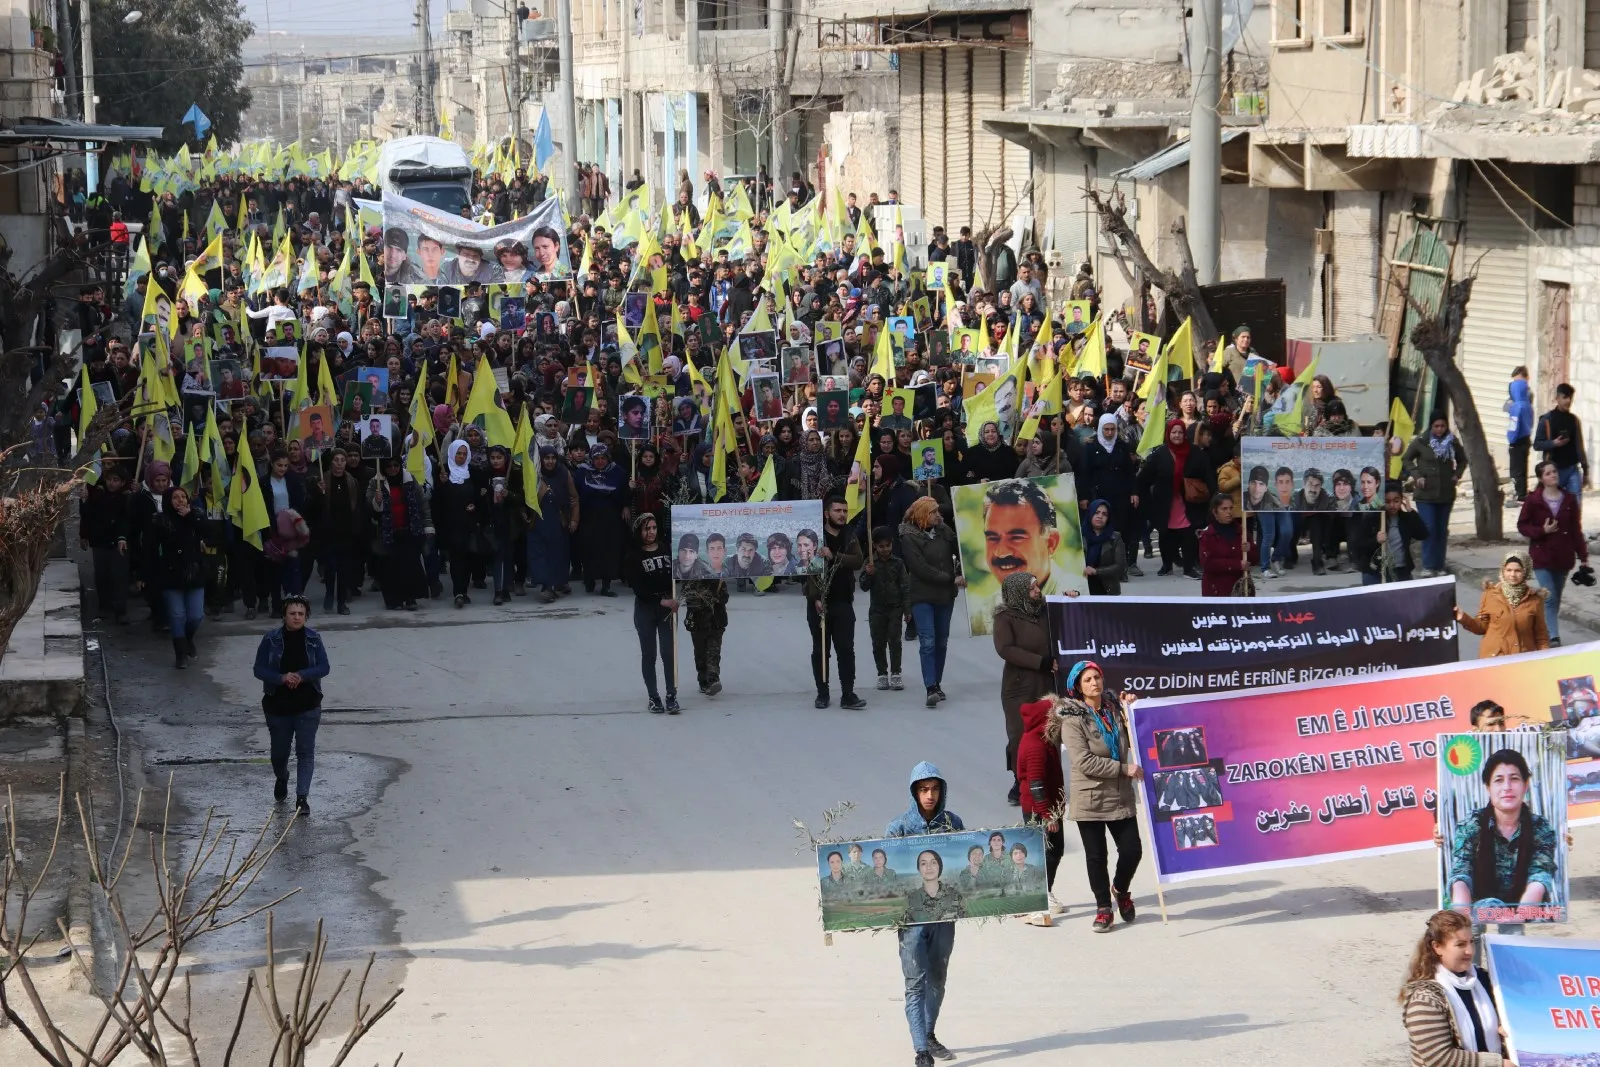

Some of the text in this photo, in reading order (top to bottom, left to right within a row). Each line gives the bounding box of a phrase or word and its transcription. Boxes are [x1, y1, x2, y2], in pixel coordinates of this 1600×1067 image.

[642, 555, 671, 572] BTS
[1191, 612, 1228, 629] عفرين
[1231, 611, 1272, 628] سنحرر
[1442, 619, 1458, 640] لن
[1316, 628, 1360, 647] الدولة
[1406, 626, 1440, 642] يدوم
[1100, 640, 1137, 657] عفرين
[1160, 637, 1204, 656] لعفرين
[1124, 676, 1155, 690] SOZ
[1208, 670, 1240, 687] EMÊ
[1243, 668, 1296, 686] EFRÎNÊ
[1296, 714, 1330, 736] EM
[1333, 709, 1348, 732] Ê
[1372, 696, 1455, 727] KUJERÊ
[1226, 740, 1437, 784] ZAROKÊN EFRÎNÊ TO
[1318, 785, 1372, 823] أطفال
[1376, 784, 1419, 817] قاتل
[1256, 800, 1312, 833] عفرين
[1558, 974, 1600, 998] BI R
[1549, 1007, 1590, 1029] EM
